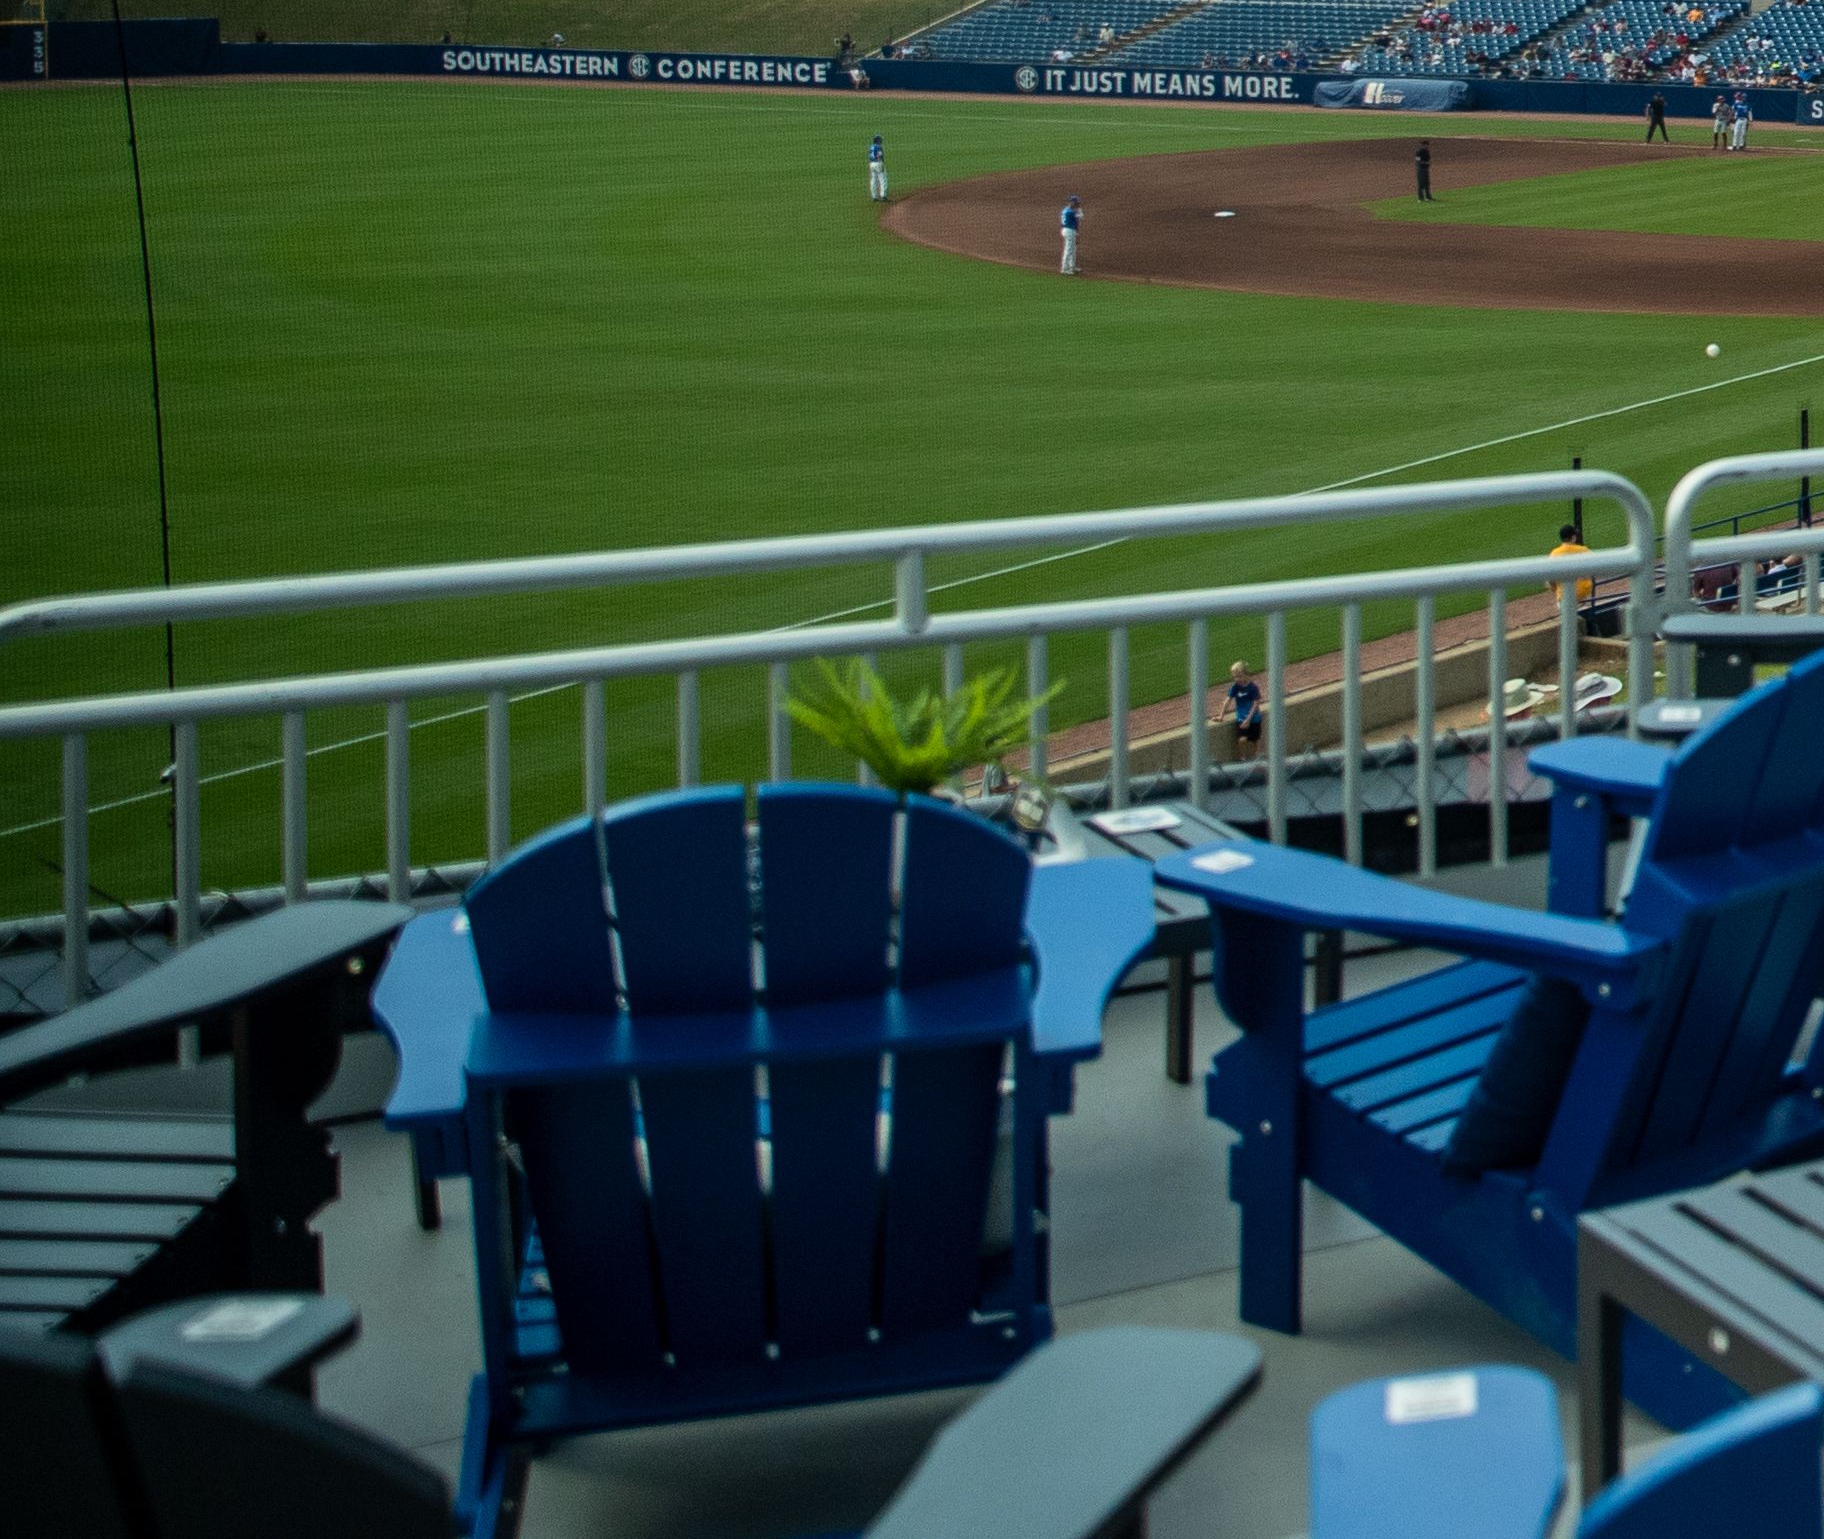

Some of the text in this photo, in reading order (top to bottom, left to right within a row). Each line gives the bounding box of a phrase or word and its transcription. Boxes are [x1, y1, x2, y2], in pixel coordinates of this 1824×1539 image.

[442, 51, 827, 84] SOUTHEASTERN SEC CONFERENCE
[1044, 68, 1067, 91] IT
[1070, 70, 1126, 94] JUST
[1133, 73, 1215, 97] MEANS
[1224, 76, 1300, 99] MORE.
